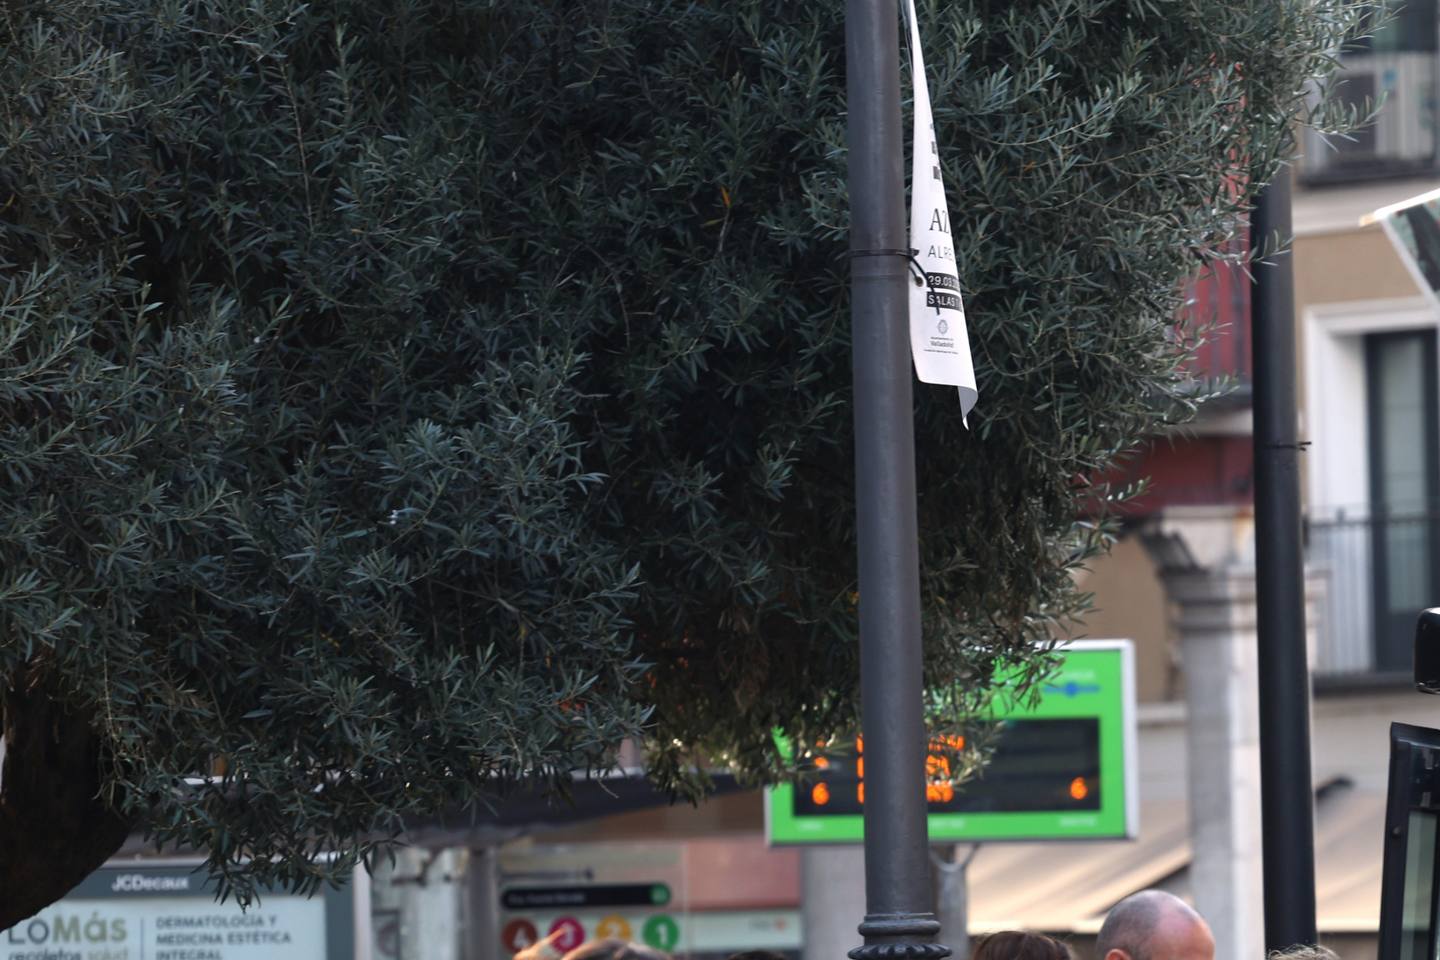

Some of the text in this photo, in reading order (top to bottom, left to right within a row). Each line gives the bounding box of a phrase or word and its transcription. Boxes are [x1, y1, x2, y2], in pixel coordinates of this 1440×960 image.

[111, 875, 188, 891] JCDecaux
[156, 914, 277, 930] DERMATOLOGÍA Y
[156, 929, 291, 946] MEDICINA ESTÉTICA
[656, 923, 668, 946] 1
